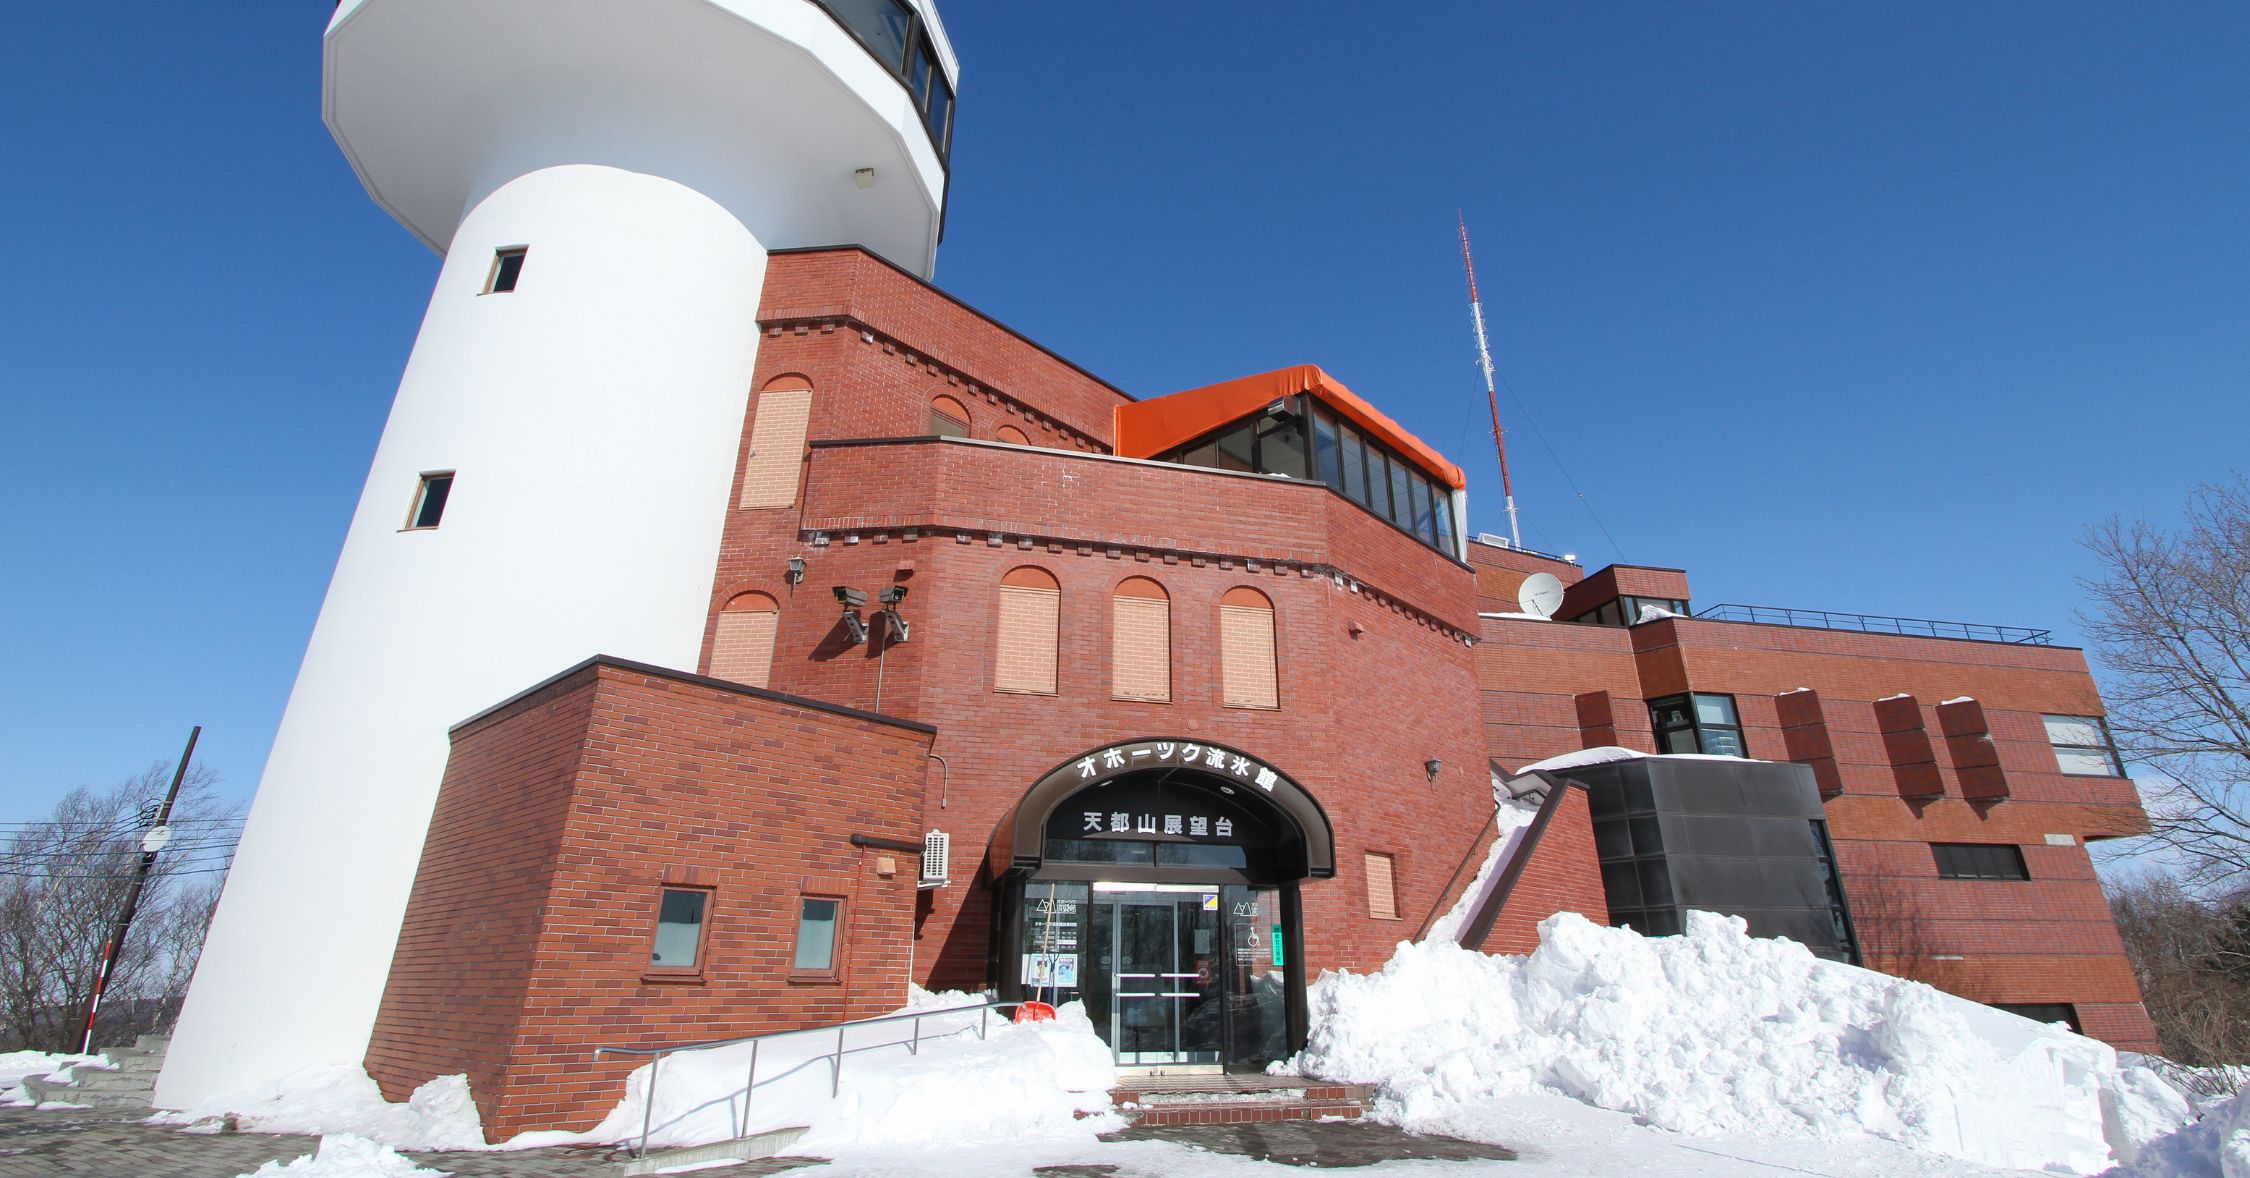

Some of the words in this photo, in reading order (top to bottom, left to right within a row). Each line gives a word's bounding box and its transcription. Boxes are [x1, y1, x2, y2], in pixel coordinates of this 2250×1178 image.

[1077, 742, 1278, 792] オホーツク流氷館
[1083, 811, 1233, 837] 天都山展望台
